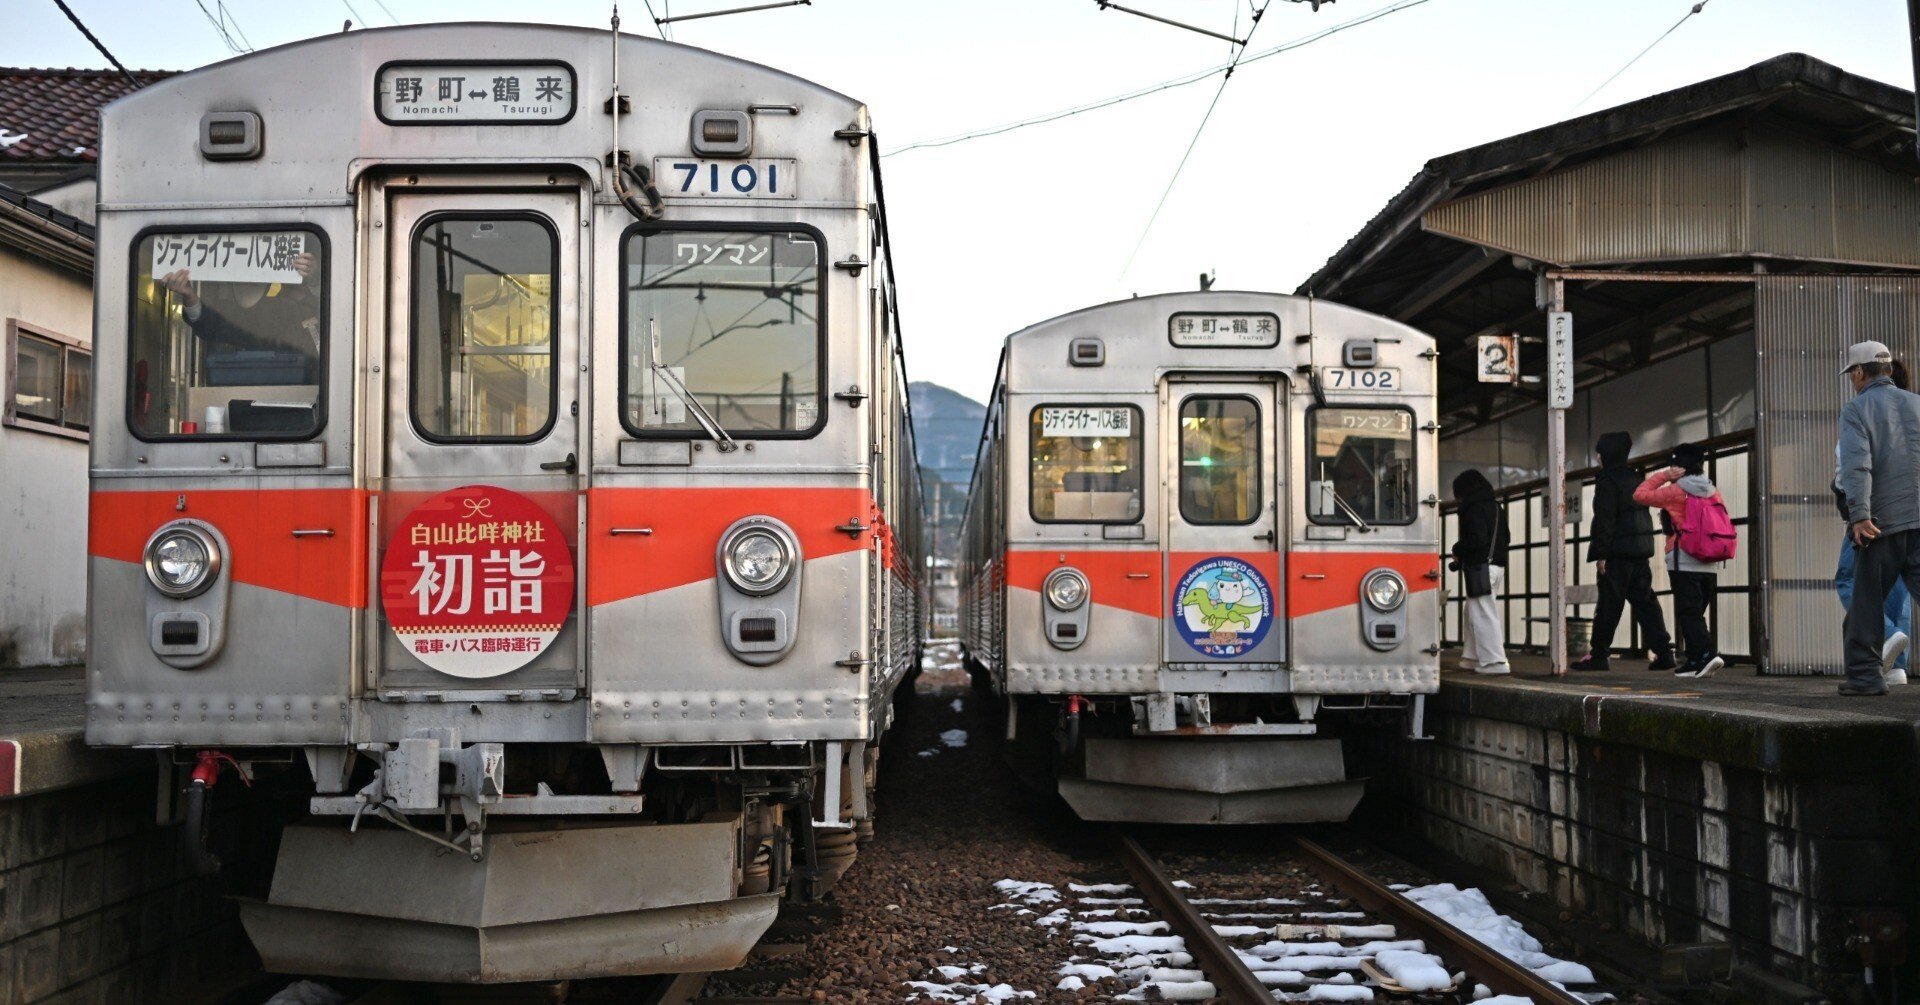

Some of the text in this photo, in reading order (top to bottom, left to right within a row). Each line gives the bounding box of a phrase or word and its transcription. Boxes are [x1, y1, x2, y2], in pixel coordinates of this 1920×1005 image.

[402, 105, 553, 115] Nomachi Tsurugi
[673, 163, 777, 193] 7101
[677, 243, 769, 265] ワンマン
[1484, 343, 1510, 375] 2
[1330, 370, 1393, 388] 7102
[1343, 416, 1394, 428] ワンマン
[411, 520, 546, 546] 白山比咩神社
[410, 549, 547, 616] 初詣
[1176, 560, 1270, 617] Hakusan Tedorigawa UNESCO Global Geopark
[414, 637, 541, 654] 電車・バス臨時運行
